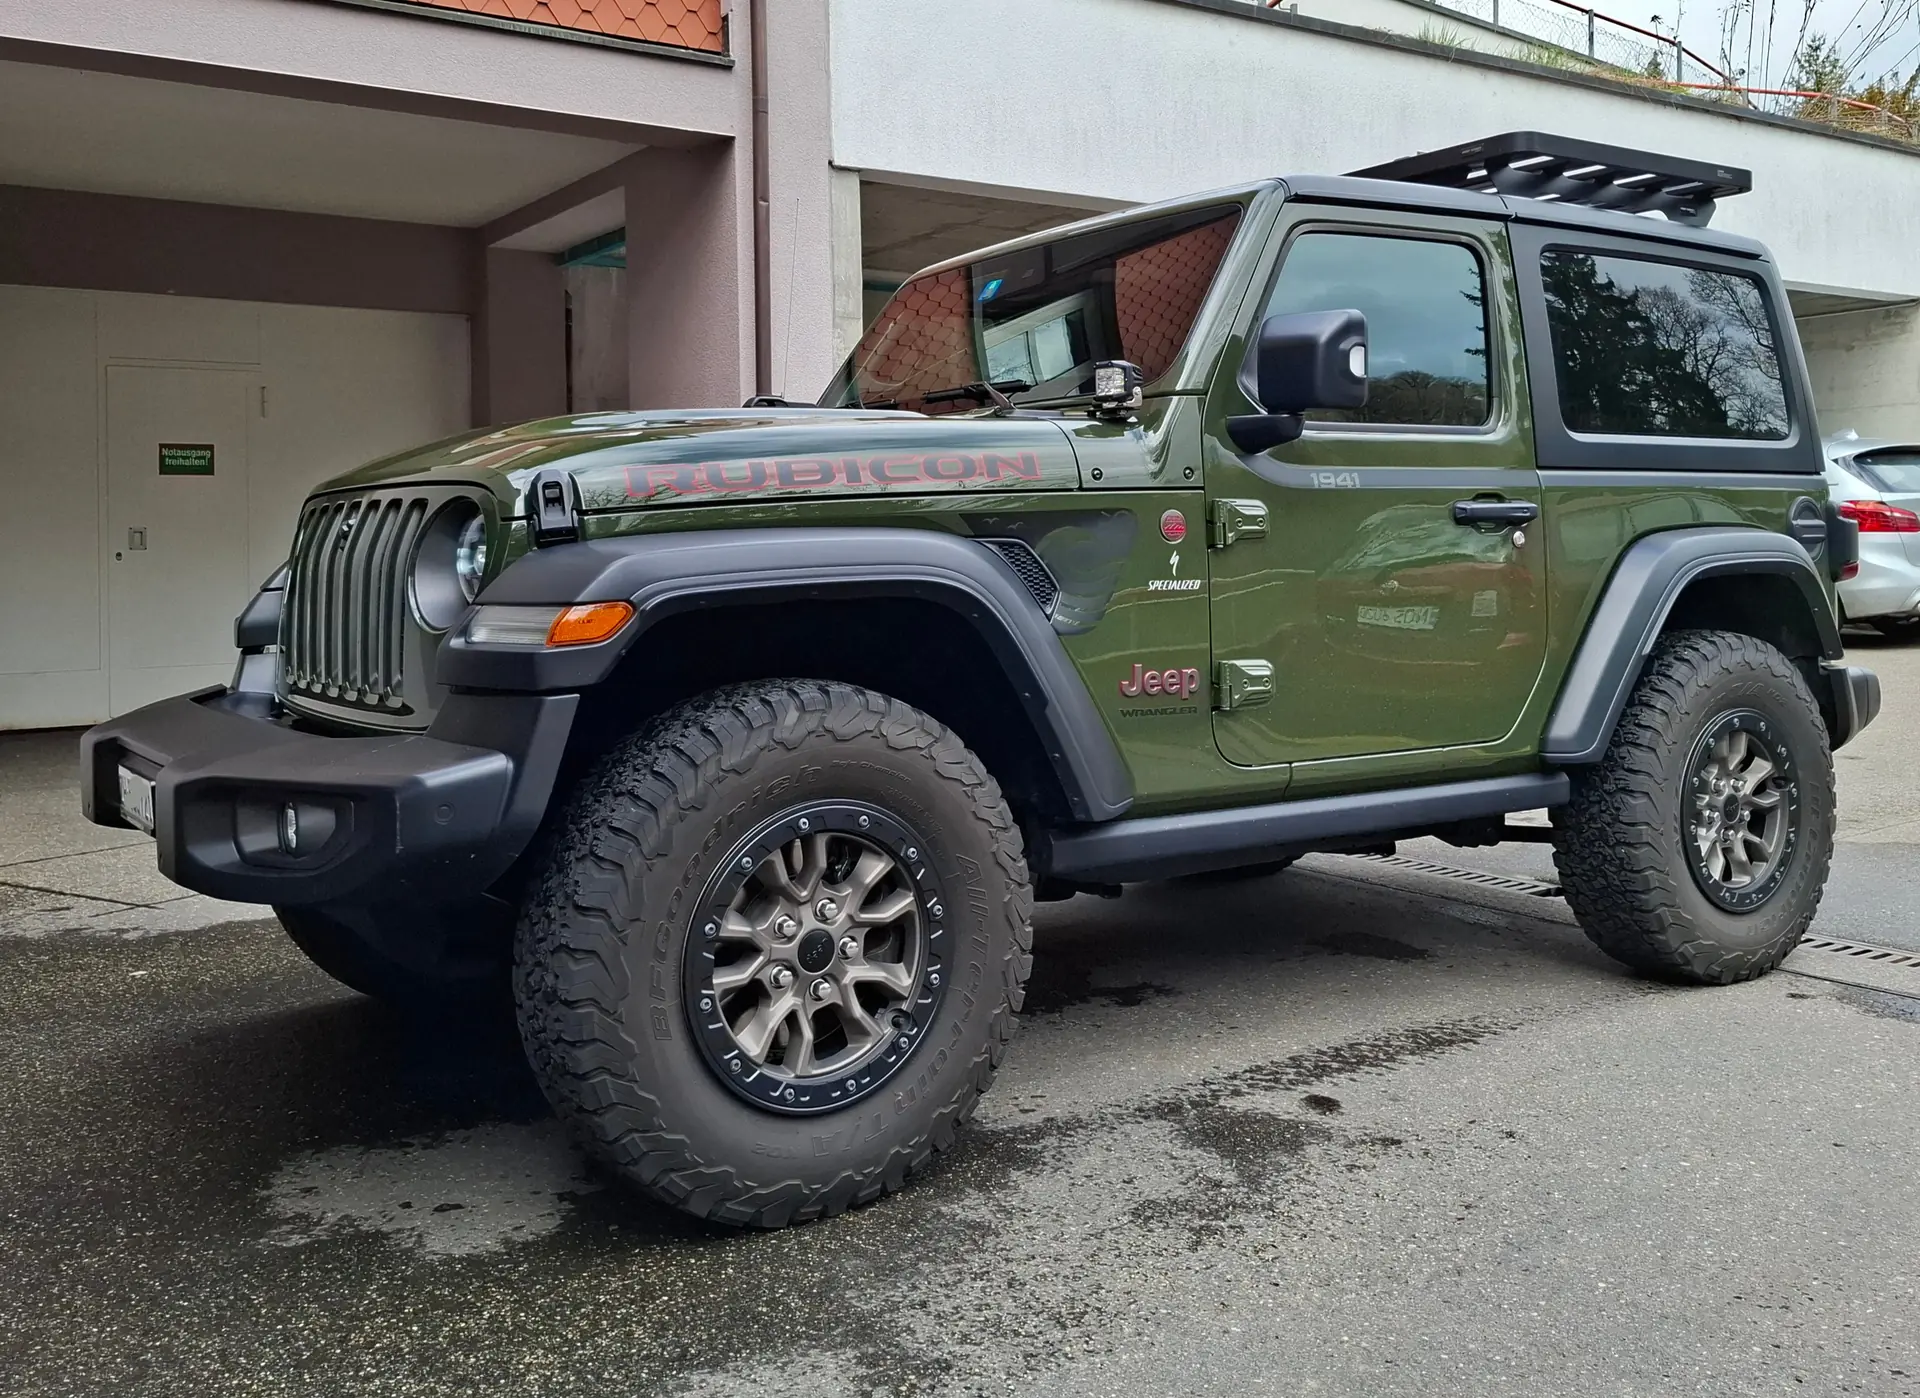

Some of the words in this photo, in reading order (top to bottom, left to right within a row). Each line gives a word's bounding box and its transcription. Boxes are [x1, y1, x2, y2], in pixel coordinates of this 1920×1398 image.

[161, 448, 211, 458] Notausgang
[165, 456, 209, 466] freihalten!
[622, 451, 1042, 497] RUBICON
[1309, 472, 1361, 488] 1941
[1147, 579, 1201, 592] SPECIALIZED
[1119, 663, 1200, 700] Jeep
[1119, 705, 1198, 719] WRANGLER
